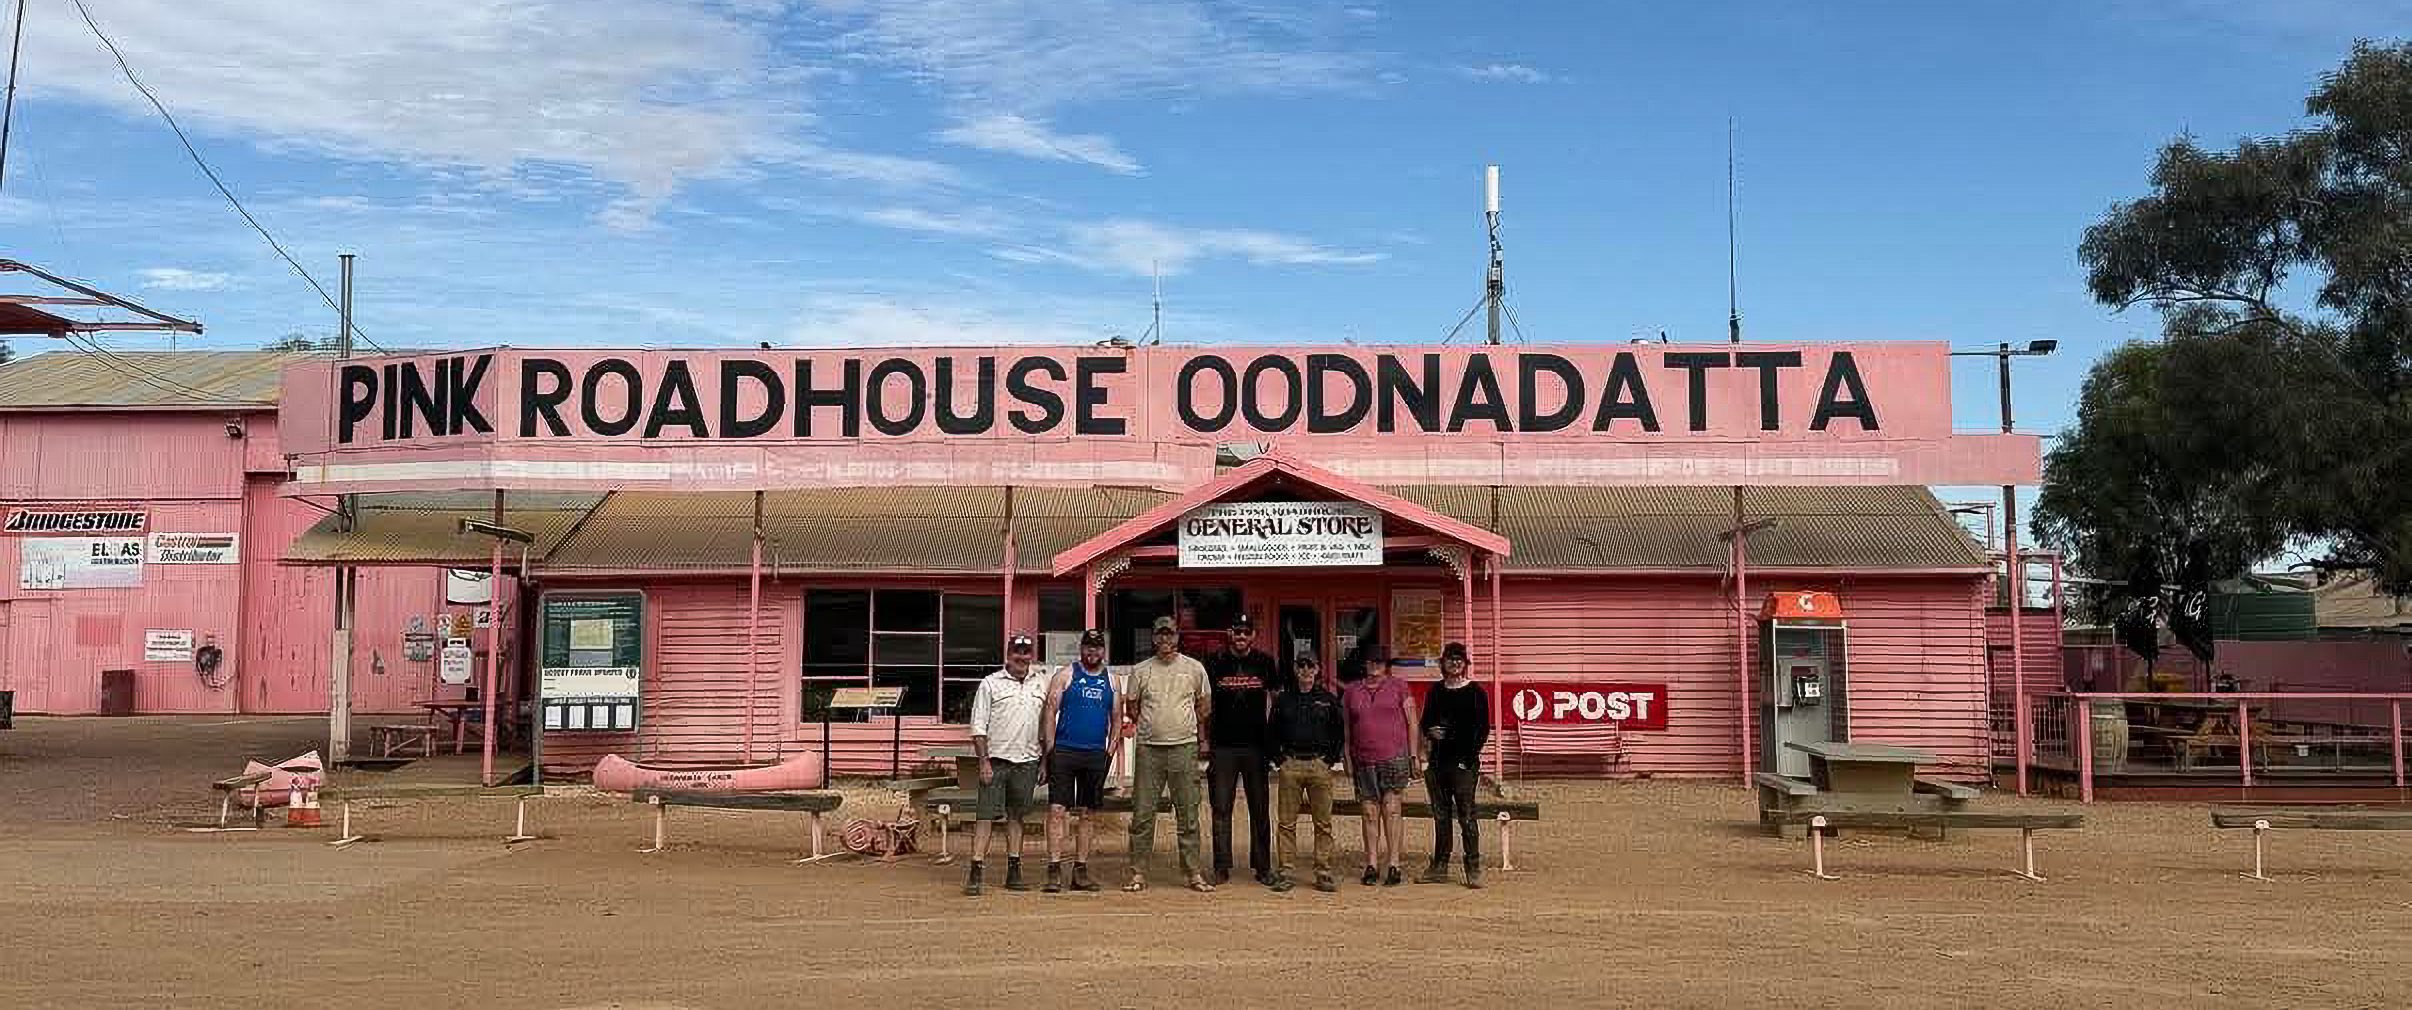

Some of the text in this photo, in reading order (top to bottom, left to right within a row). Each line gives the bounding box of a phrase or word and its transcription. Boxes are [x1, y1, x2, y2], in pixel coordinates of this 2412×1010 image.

[339, 351, 1879, 443] PINK ROADHOUSE OODNADATTA
[6, 510, 145, 531] BRIDGESTONE
[1186, 516, 1374, 539] GENERAL STORE
[91, 543, 140, 557] ELAS
[1554, 692, 1653, 719] POST
